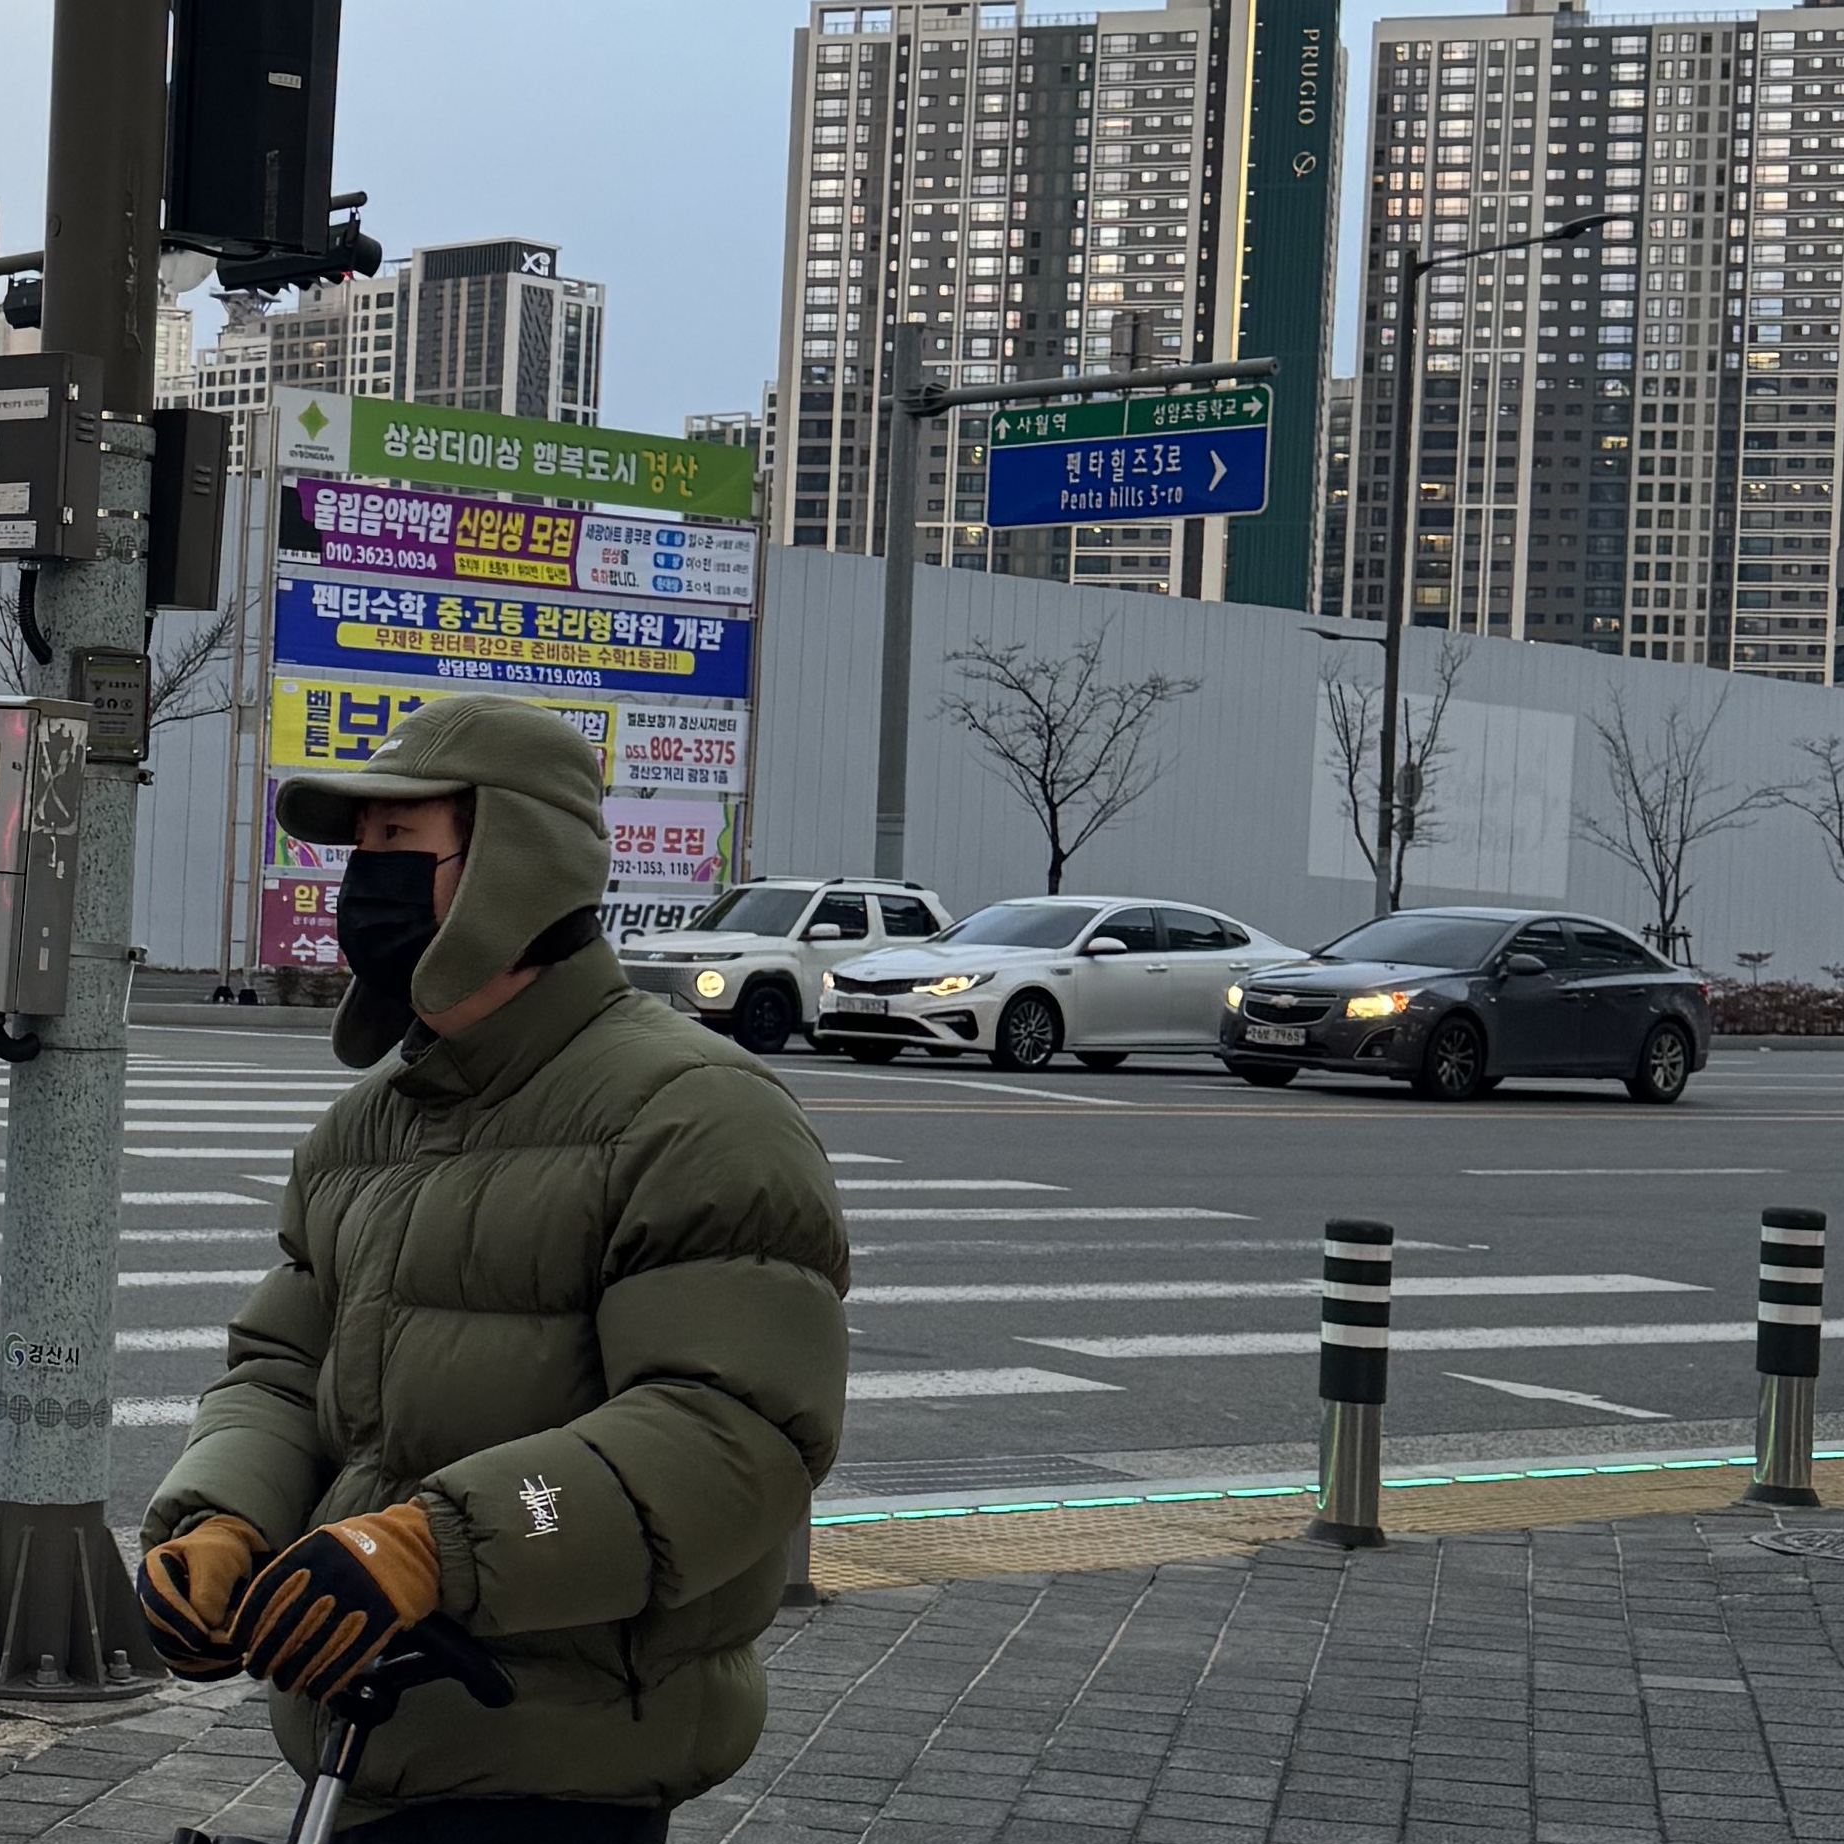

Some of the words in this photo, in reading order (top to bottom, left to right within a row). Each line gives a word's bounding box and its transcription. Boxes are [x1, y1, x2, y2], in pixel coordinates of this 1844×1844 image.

[1296, 28, 1321, 126] PRUGIO
[1017, 411, 1068, 436] 사월역
[1153, 398, 1237, 426] 성암초등학교
[383, 422, 523, 471] 상상더이상
[532, 441, 637, 486] 행복도시
[642, 450, 698, 497] 경산
[1066, 444, 1182, 485] 펜타힐즈3로
[1061, 489, 1103, 511] Penta
[1109, 484, 1144, 508] hills
[1149, 484, 1183, 507] 3-ro
[313, 488, 453, 544] 울림음악학원
[455, 507, 526, 553] 신입생
[528, 514, 576, 558] 모집
[326, 541, 437, 571] 010.3623.0034
[311, 583, 427, 626] 펜타수학
[534, 604, 664, 648] 관리형학원
[672, 617, 725, 651] 개관
[375, 627, 423, 649] 무제한
[429, 631, 525, 659] 윈터특강으로
[530, 641, 592, 666] 준비하는
[597, 648, 678, 671] 수학1등급!!
[437, 658, 493, 680] 상담문의
[506, 663, 602, 687] 053.719.0203
[628, 765, 684, 782] 경산오거리
[688, 767, 709, 784] 광장
[713, 770, 729, 785] 1층
[610, 825, 657, 855] 강생
[662, 827, 706, 856] 모집
[28, 1343, 80, 1367] 경산시
